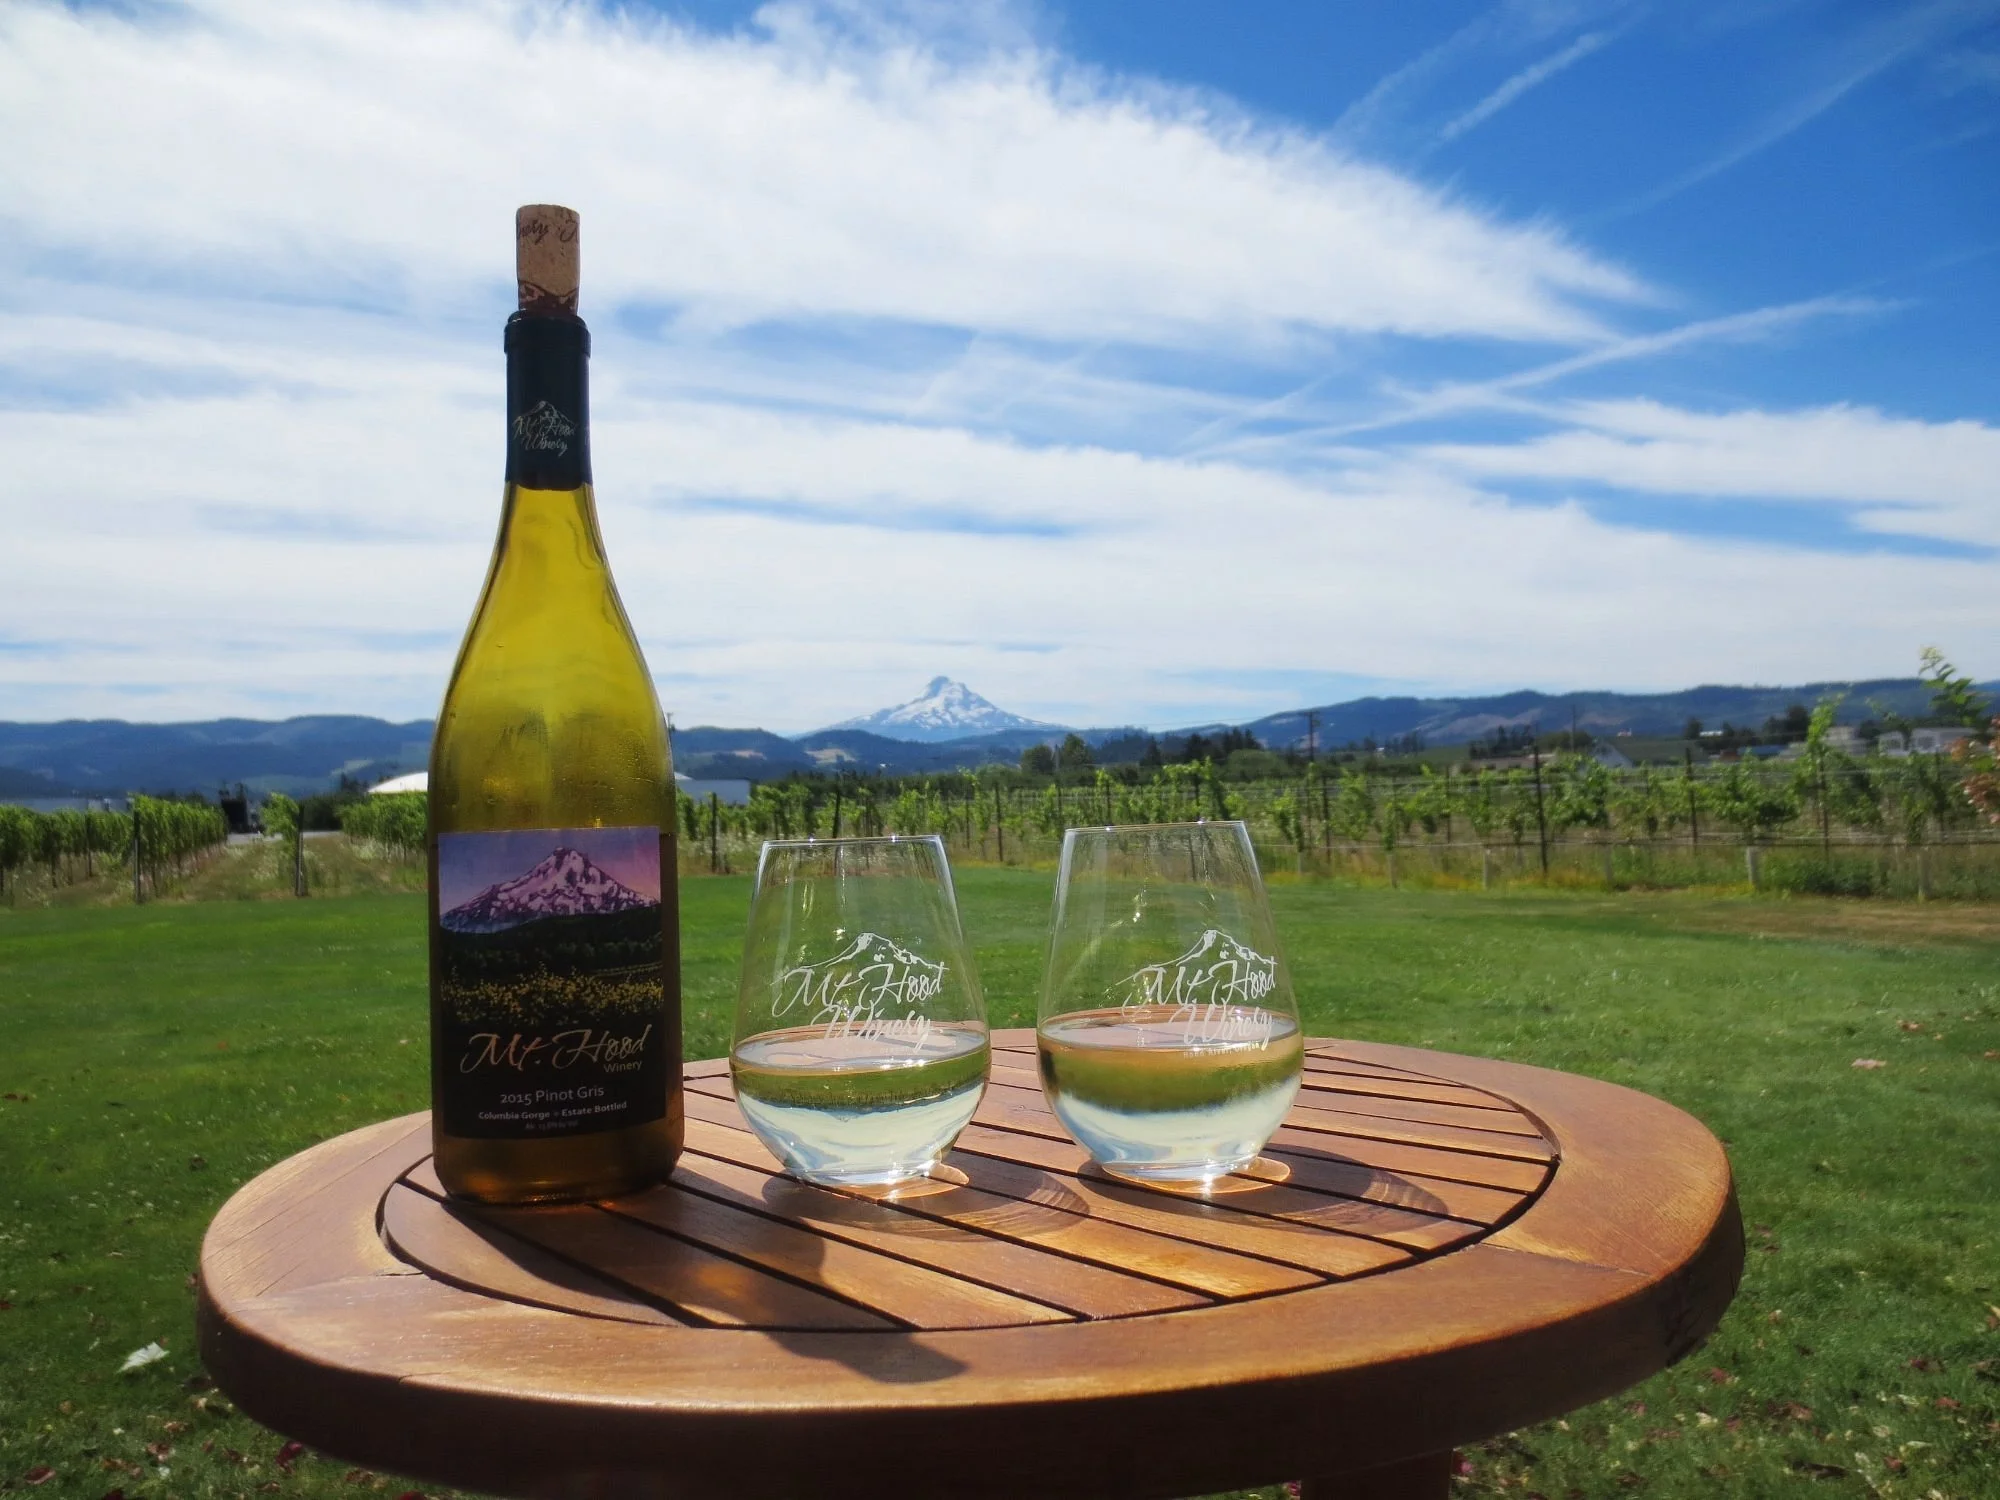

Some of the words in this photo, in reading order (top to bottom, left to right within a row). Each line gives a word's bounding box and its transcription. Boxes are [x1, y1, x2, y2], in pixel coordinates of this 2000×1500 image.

[858, 961, 946, 1011] Hood
[1208, 957, 1276, 1007] Hood
[551, 1023, 652, 1069] Hood
[810, 999, 931, 1052] Winery
[1169, 997, 1273, 1051] Winery
[603, 1060, 643, 1074] Winery
[478, 1110, 520, 1121] Columbia
[521, 1110, 550, 1122] Gorge
[561, 1106, 592, 1118] Estate
[594, 1101, 628, 1113] Bottled
[500, 1093, 533, 1106] 2015
[535, 1089, 574, 1103] Pinot
[576, 1084, 605, 1098] Gris
